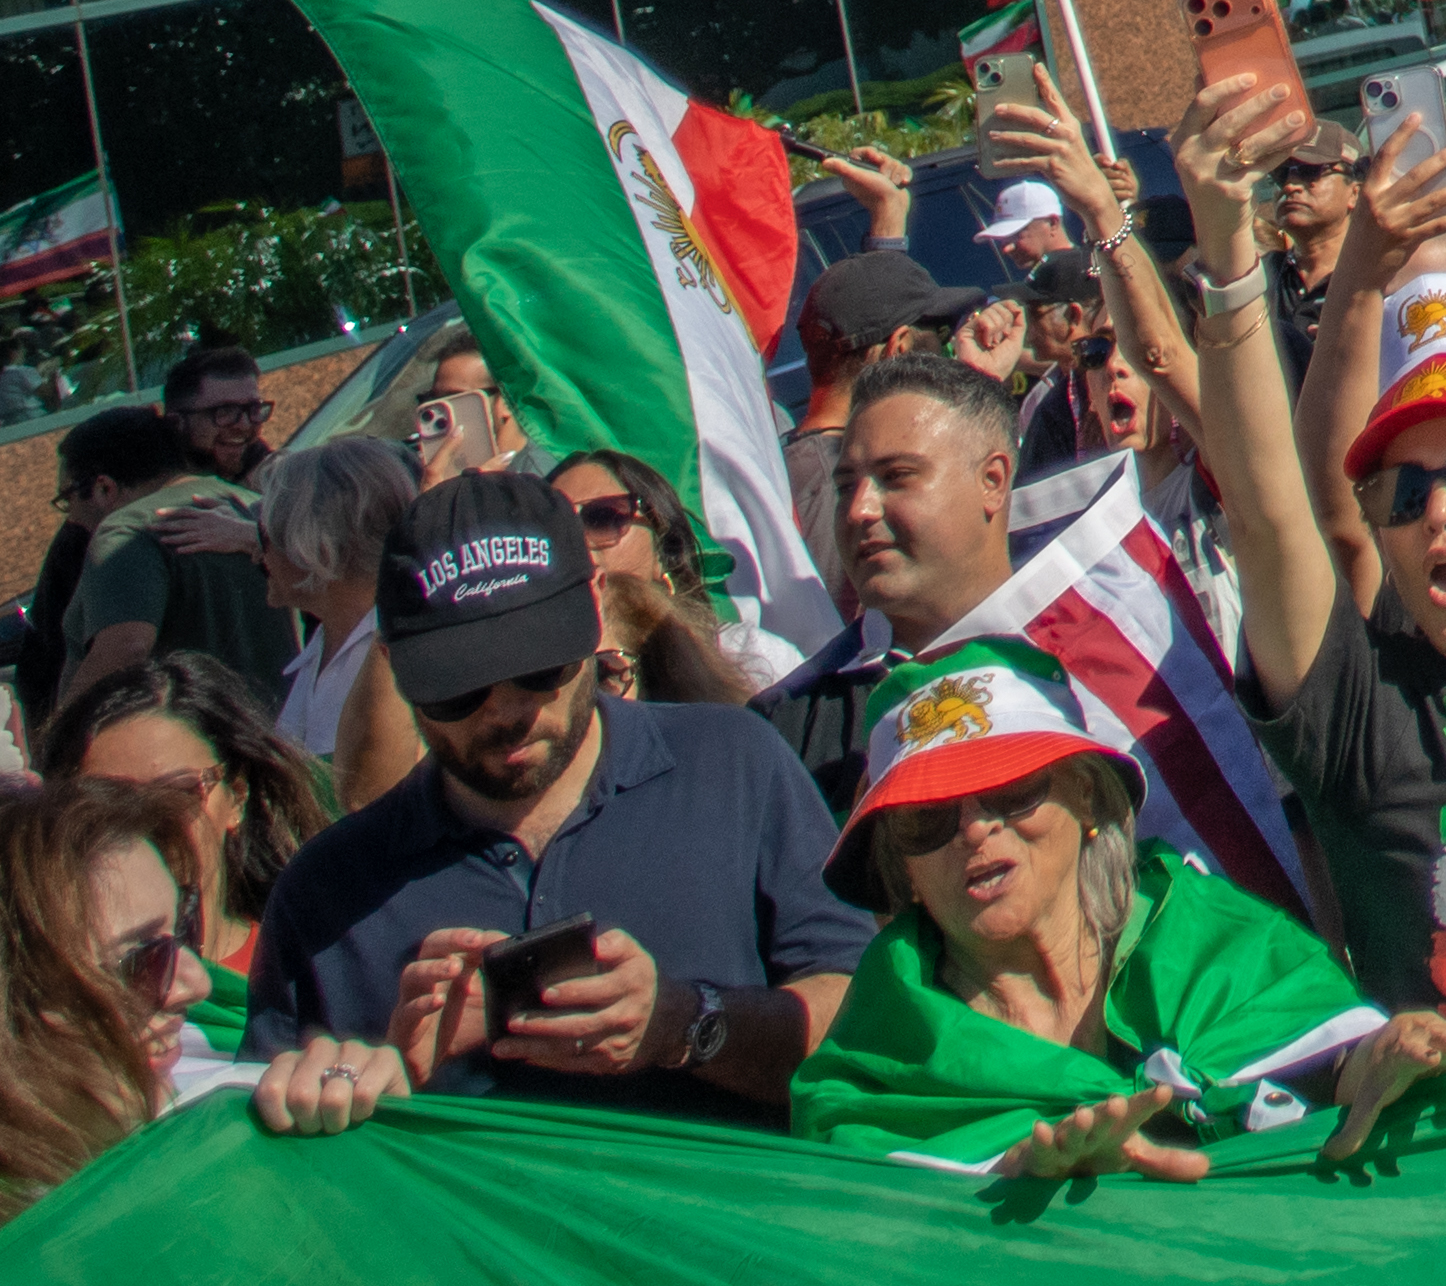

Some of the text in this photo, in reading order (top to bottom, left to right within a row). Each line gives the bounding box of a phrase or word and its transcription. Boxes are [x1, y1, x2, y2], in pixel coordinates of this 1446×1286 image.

[417, 536, 550, 598] LOS ANGELES
[453, 573, 530, 602] California
